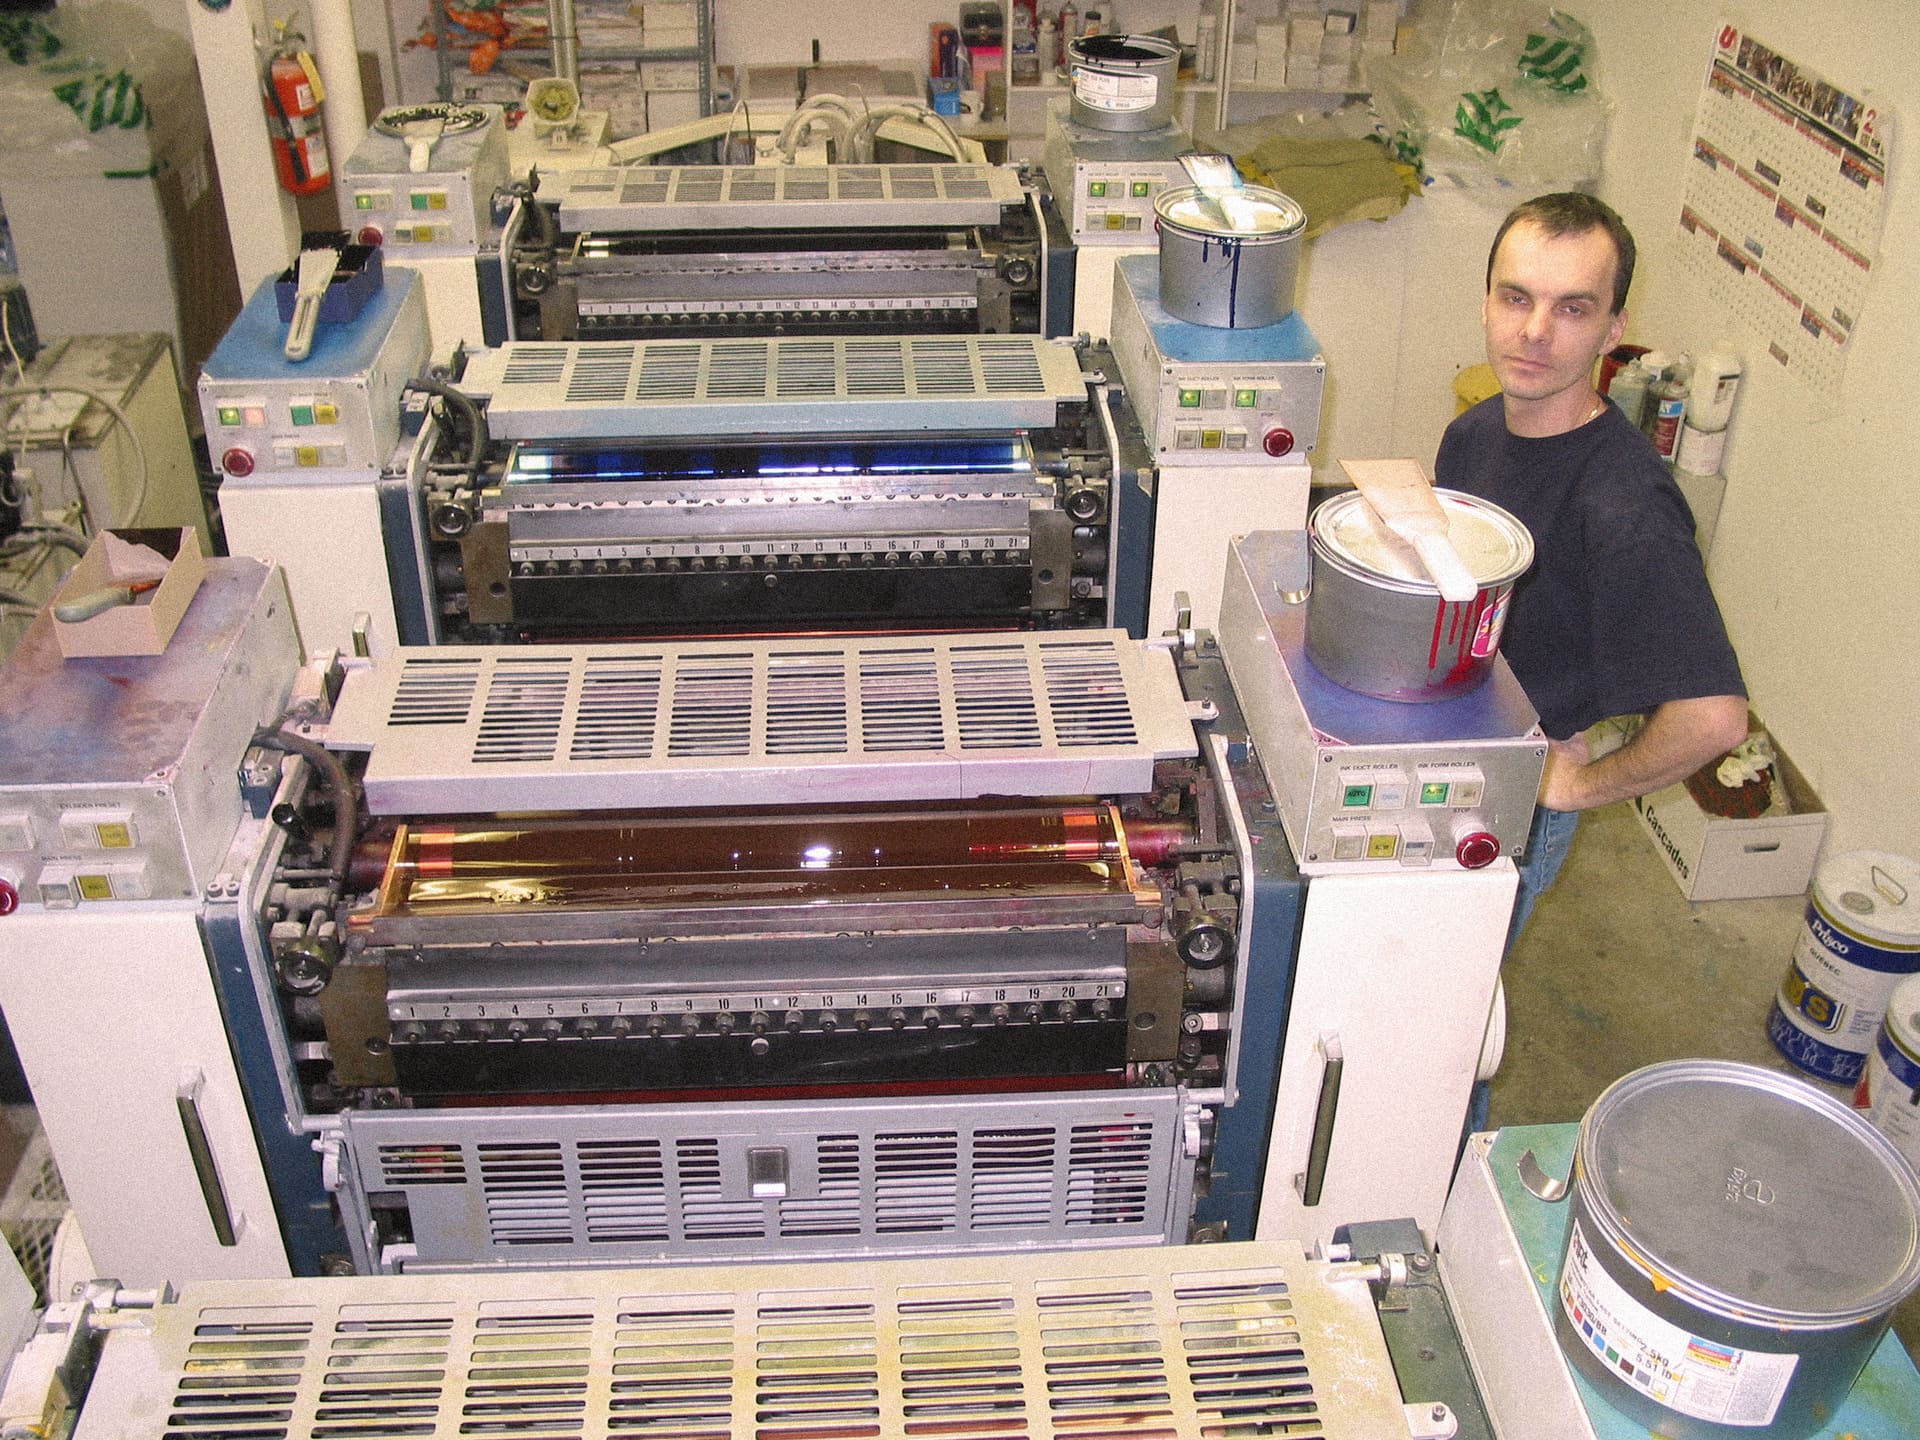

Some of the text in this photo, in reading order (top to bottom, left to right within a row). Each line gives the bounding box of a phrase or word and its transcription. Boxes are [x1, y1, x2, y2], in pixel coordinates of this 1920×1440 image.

[742, 544, 751, 554] 10
[767, 543, 774, 553] 11
[790, 542, 799, 552] 12
[815, 542, 824, 552] 13
[839, 541, 847, 551] 14
[863, 540, 872, 551] 15
[888, 540, 897, 550] 16
[912, 540, 920, 549] 17
[936, 539, 945, 549] 18
[961, 538, 969, 549] 19
[984, 538, 994, 548] 20
[1009, 537, 1018, 548] 21
[1646, 805, 1689, 880] Cascades
[410, 985, 1108, 1018] 1 2 3 4 5 6 7 8 9 10 11 12 13 14 15 16 17 18 19 20 21
